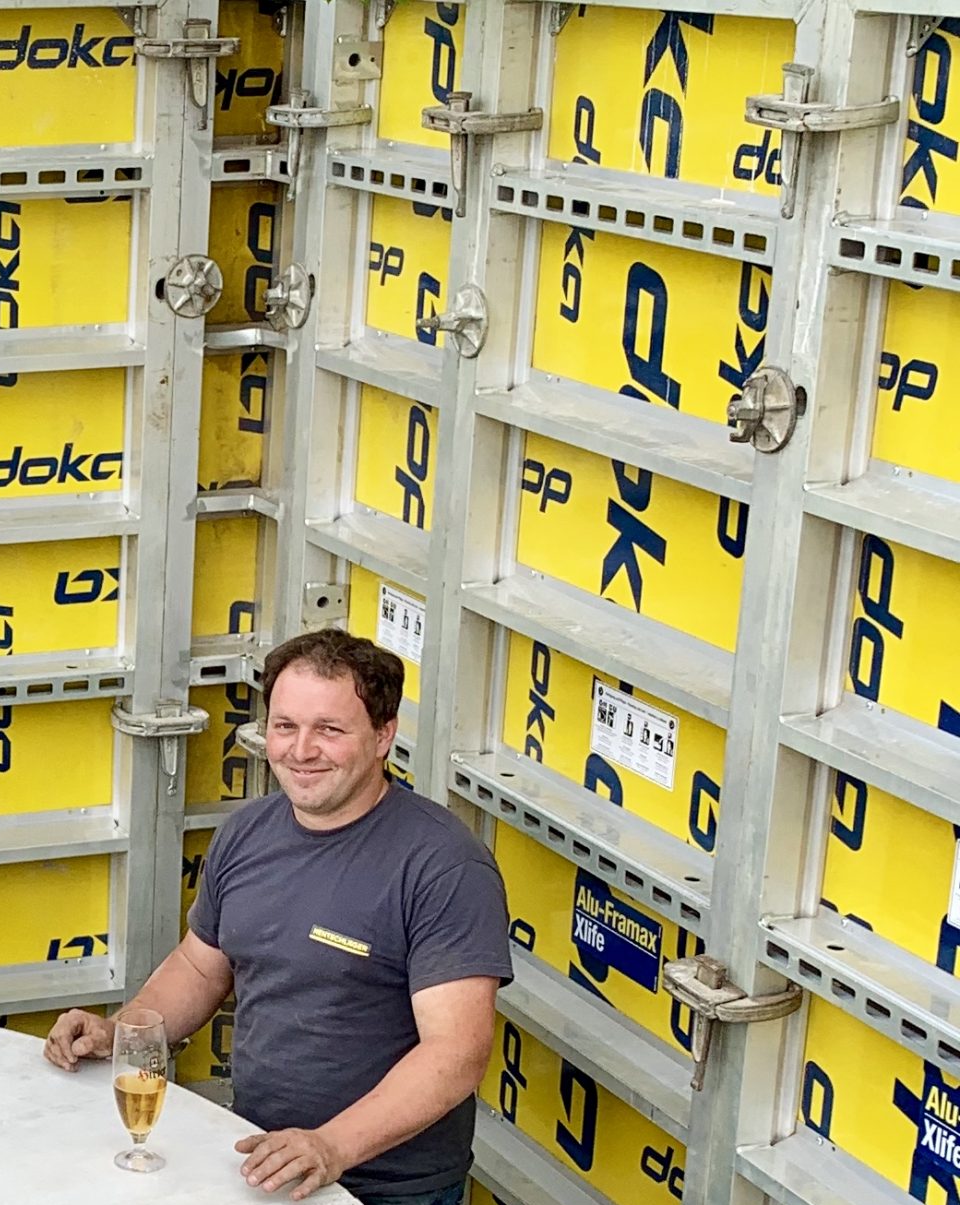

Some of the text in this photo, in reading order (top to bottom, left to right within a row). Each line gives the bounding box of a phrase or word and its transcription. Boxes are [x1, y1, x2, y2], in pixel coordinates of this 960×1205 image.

[574, 912, 605, 952] Xlife
[576, 885, 658, 954] Alu-Framax
[925, 1085, 960, 1127] Alu
